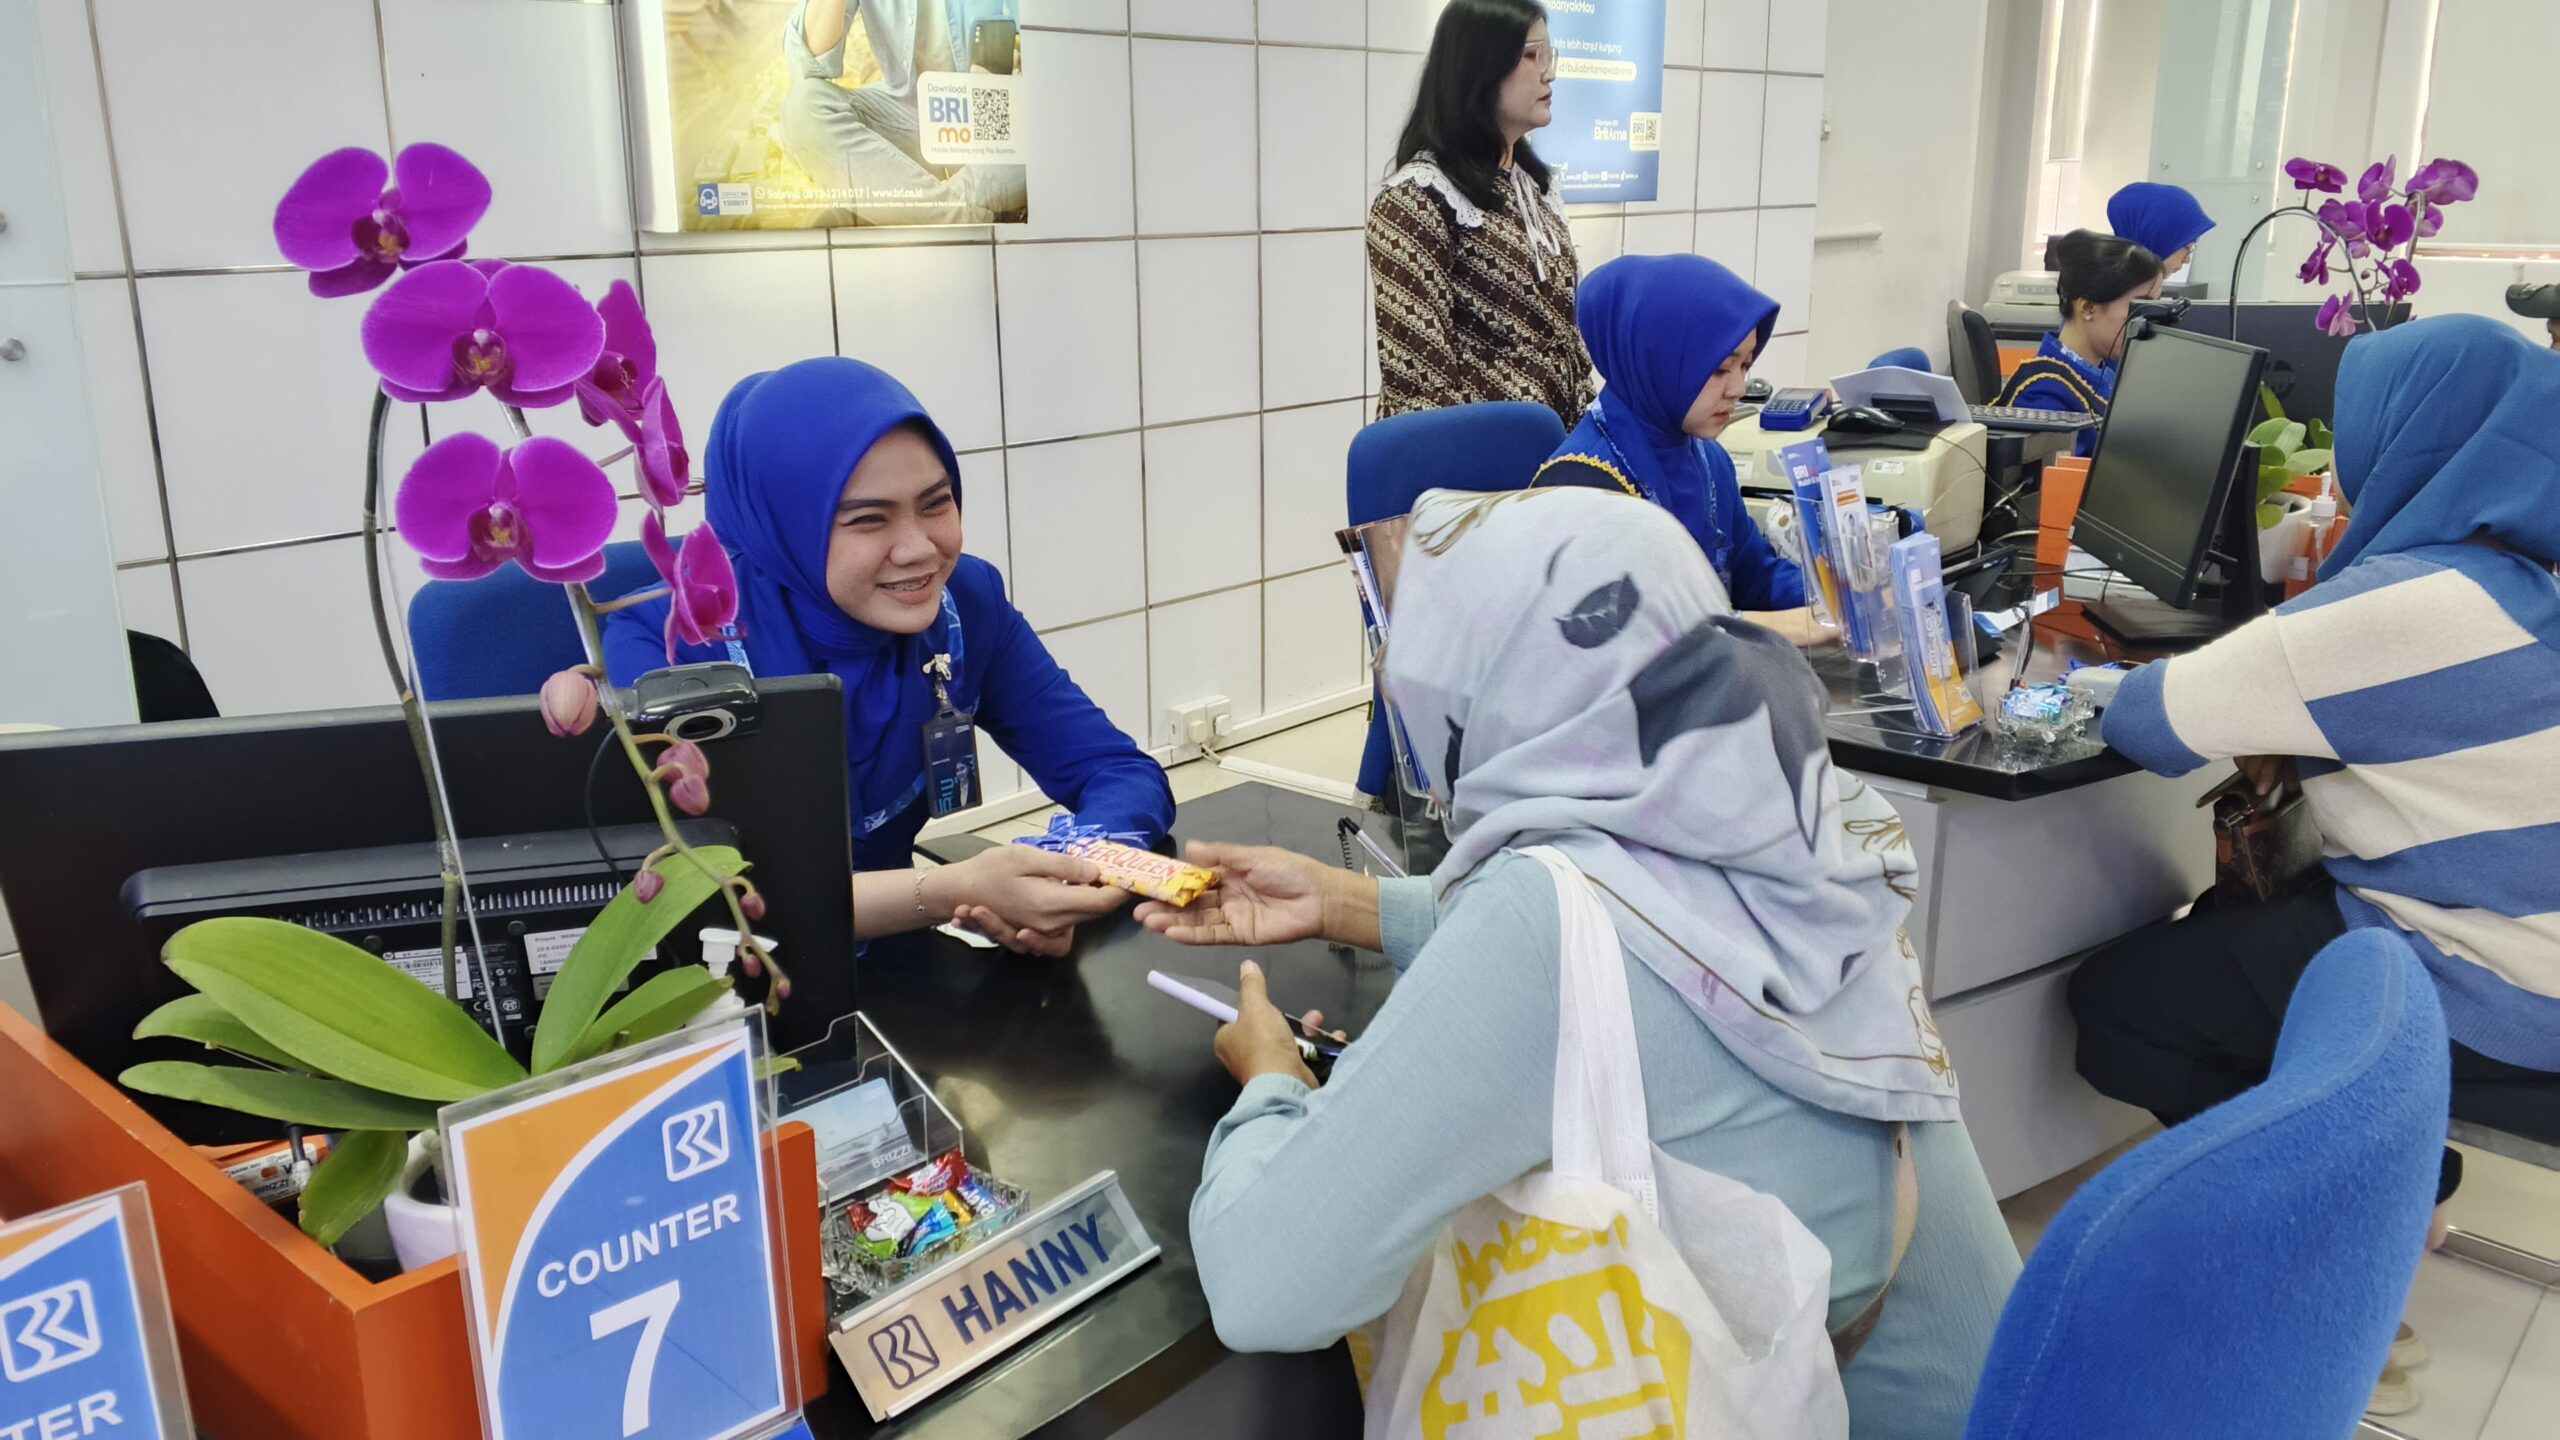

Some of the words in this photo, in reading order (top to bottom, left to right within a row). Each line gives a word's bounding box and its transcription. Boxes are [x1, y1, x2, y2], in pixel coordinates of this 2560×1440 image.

[928, 84, 967, 94] Download
[929, 97, 969, 123] BRI
[938, 127, 971, 144] mo
[871, 1145, 912, 1169] BRIZZI
[537, 1194, 742, 1298] COUNTER
[940, 1213, 1110, 1345] HANNY
[589, 1279, 681, 1438] 7
